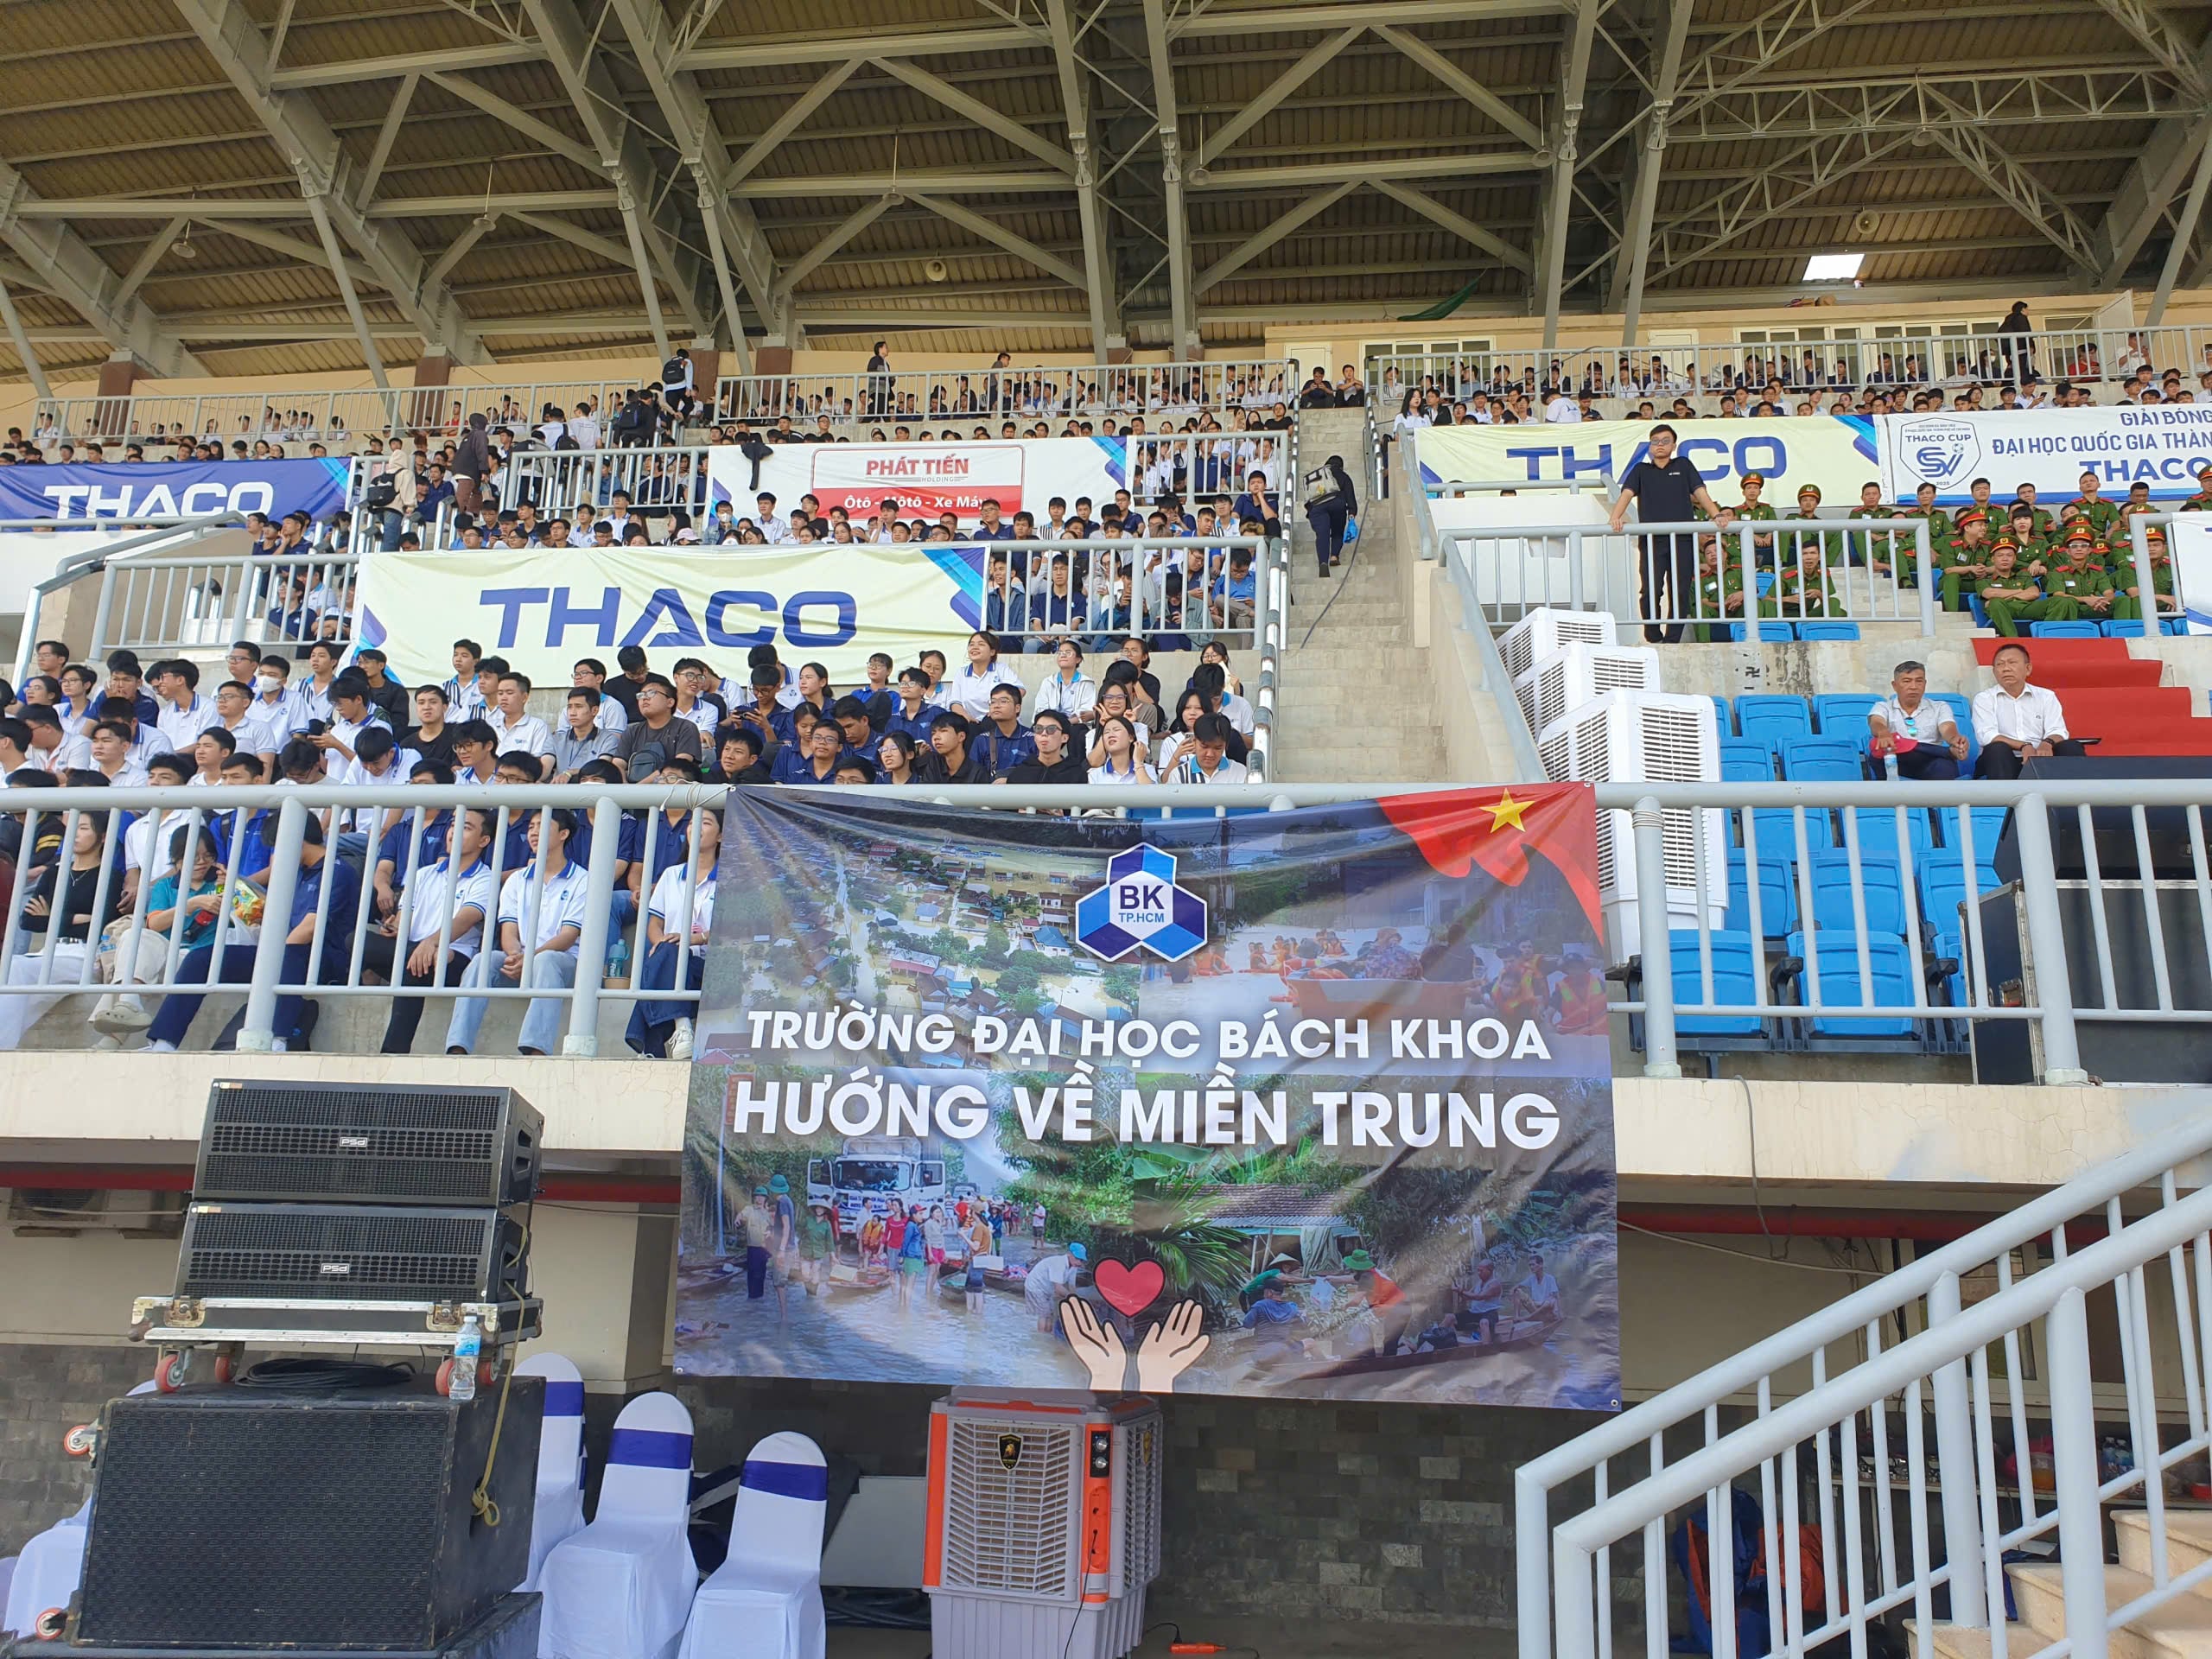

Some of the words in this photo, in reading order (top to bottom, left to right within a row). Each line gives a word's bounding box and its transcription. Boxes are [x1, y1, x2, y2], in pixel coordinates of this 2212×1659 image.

[2120, 408, 2159, 426] GIẢI
[1993, 437, 2024, 456] ĐẠI
[2030, 435, 2067, 456] HỌC
[2072, 431, 2121, 452] QUỐC
[2126, 433, 2158, 450] GIA
[866, 456, 920, 475] PHÁT
[923, 453, 969, 475] TIẾN
[43, 481, 274, 518] THACO
[843, 495, 872, 509] Ôtô
[935, 496, 952, 508] Xe
[480, 587, 857, 648] THACO
[1120, 885, 1165, 909] BK
[1118, 912, 1165, 923] TP.HCM
[747, 999, 955, 1052] TRƯỜNG
[971, 1015, 1060, 1065] ĐẠI
[1080, 1019, 1200, 1067] HỌC
[1219, 1007, 1370, 1059] BÁCH
[1390, 1017, 1552, 1060] KHOA
[733, 1065, 989, 1139] HƯỚNG
[1014, 1059, 1094, 1141] VỀ
[1120, 1060, 1287, 1145] MIỀN
[1312, 1091, 1560, 1149] TRUNG
